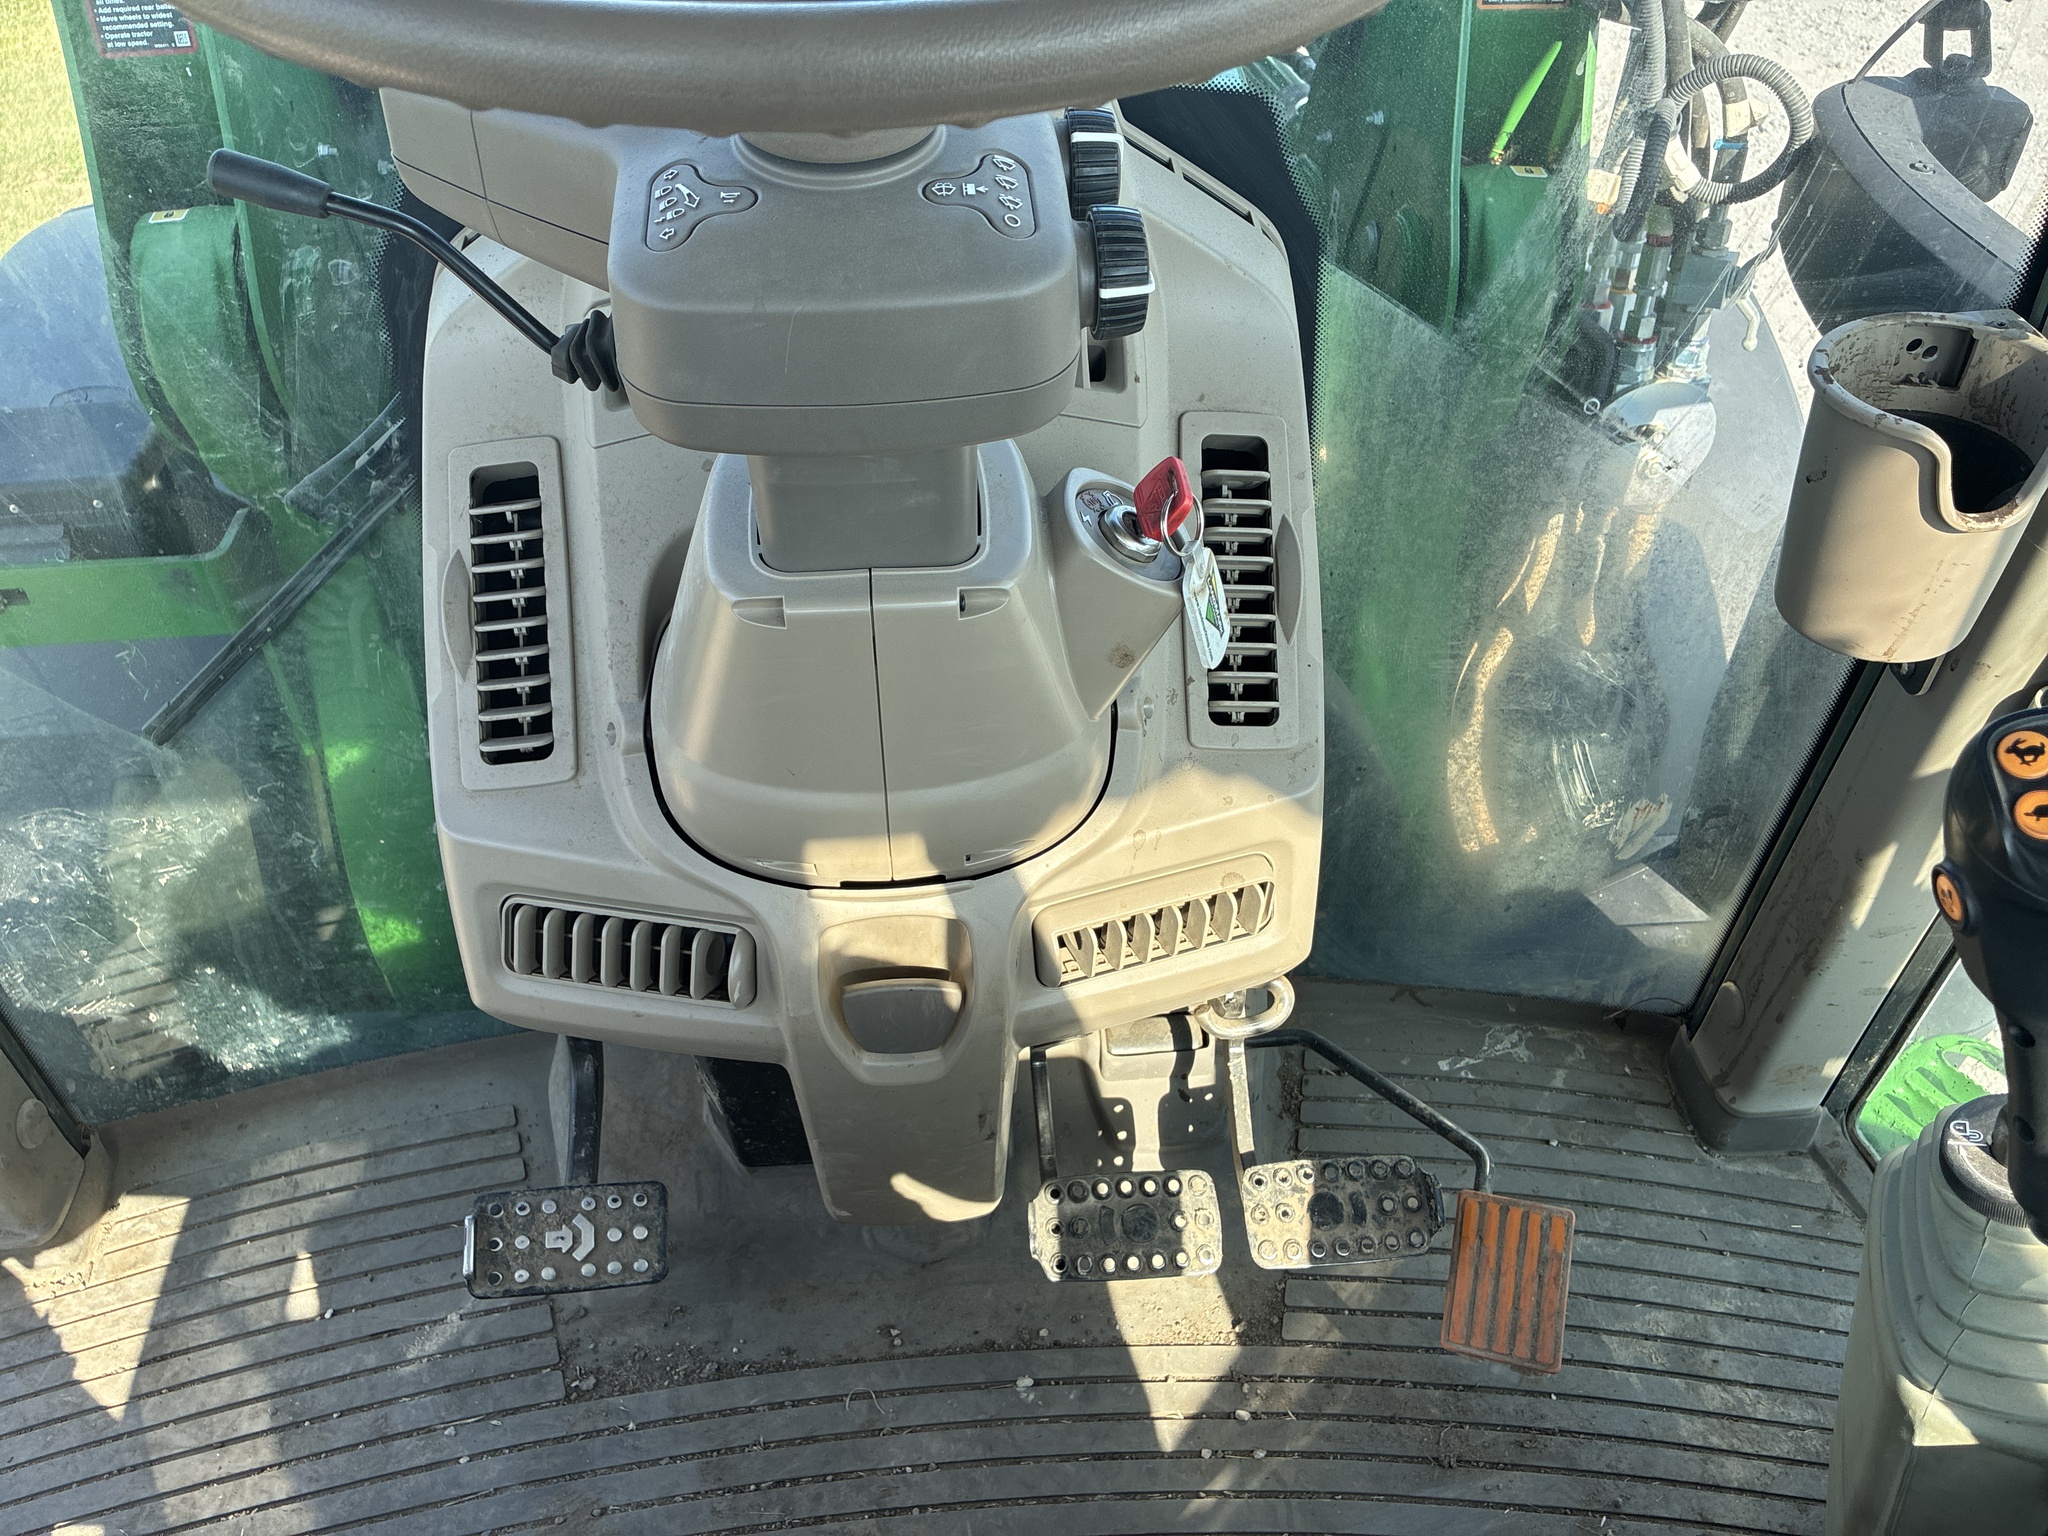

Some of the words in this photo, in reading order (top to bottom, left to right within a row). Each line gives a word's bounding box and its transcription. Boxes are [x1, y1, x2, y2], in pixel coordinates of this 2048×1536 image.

[113, 5, 140, 13] required
[102, 22, 149, 31] recommended
[150, 21, 174, 29] setting.
[104, 32, 131, 40] Operate
[127, 39, 149, 48] speed.
